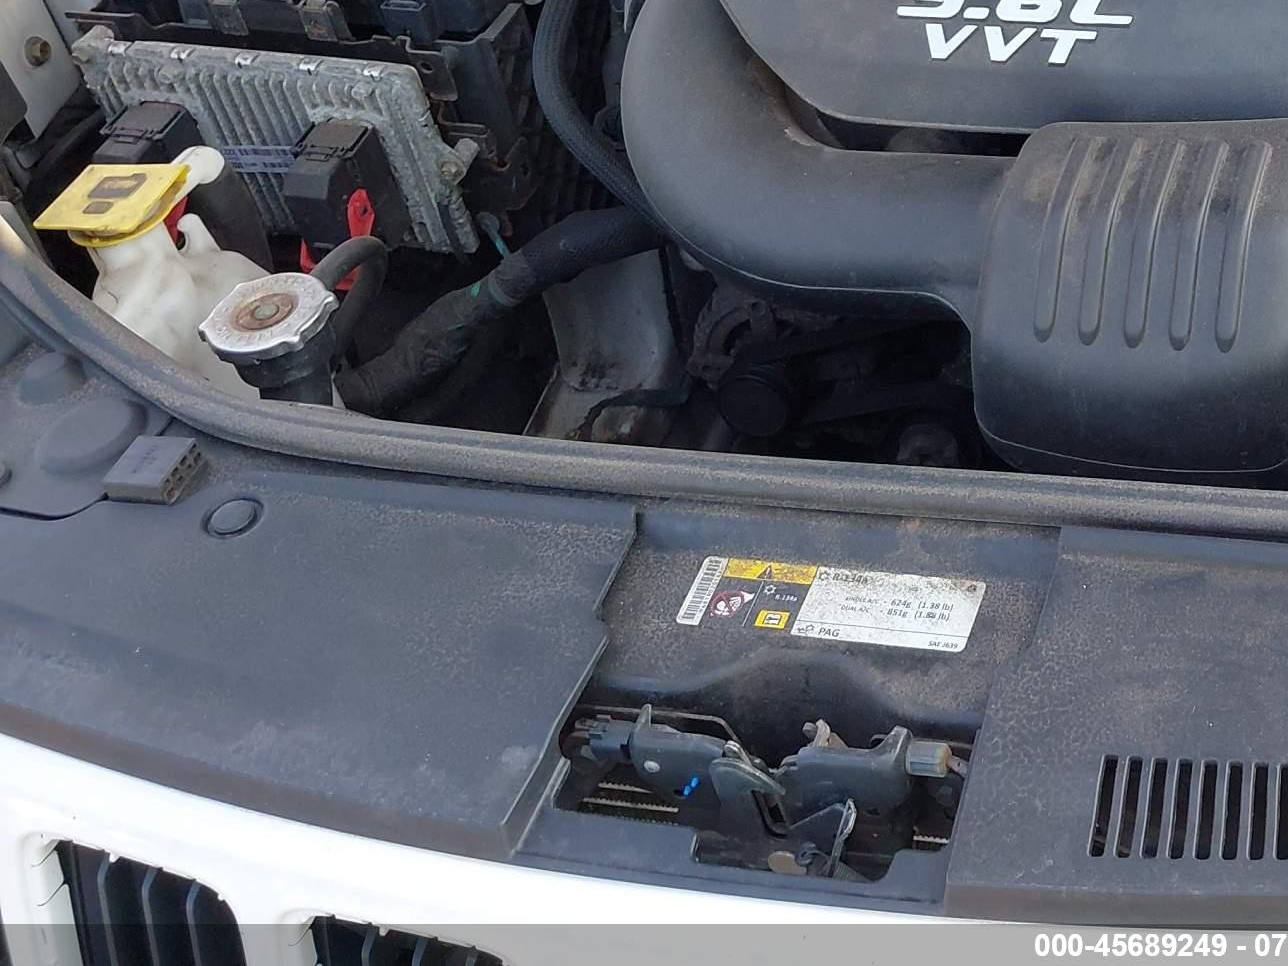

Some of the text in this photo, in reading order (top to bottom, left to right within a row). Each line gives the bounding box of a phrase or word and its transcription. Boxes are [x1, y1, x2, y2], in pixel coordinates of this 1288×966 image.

[924, 23, 1098, 65] VVT
[890, 599, 912, 609] 624g
[918, 601, 941, 610] (1.38
[942, 602, 954, 612] lb)
[938, 612, 951, 622] lb)
[818, 627, 840, 638] PAG
[942, 641, 958, 650] J639
